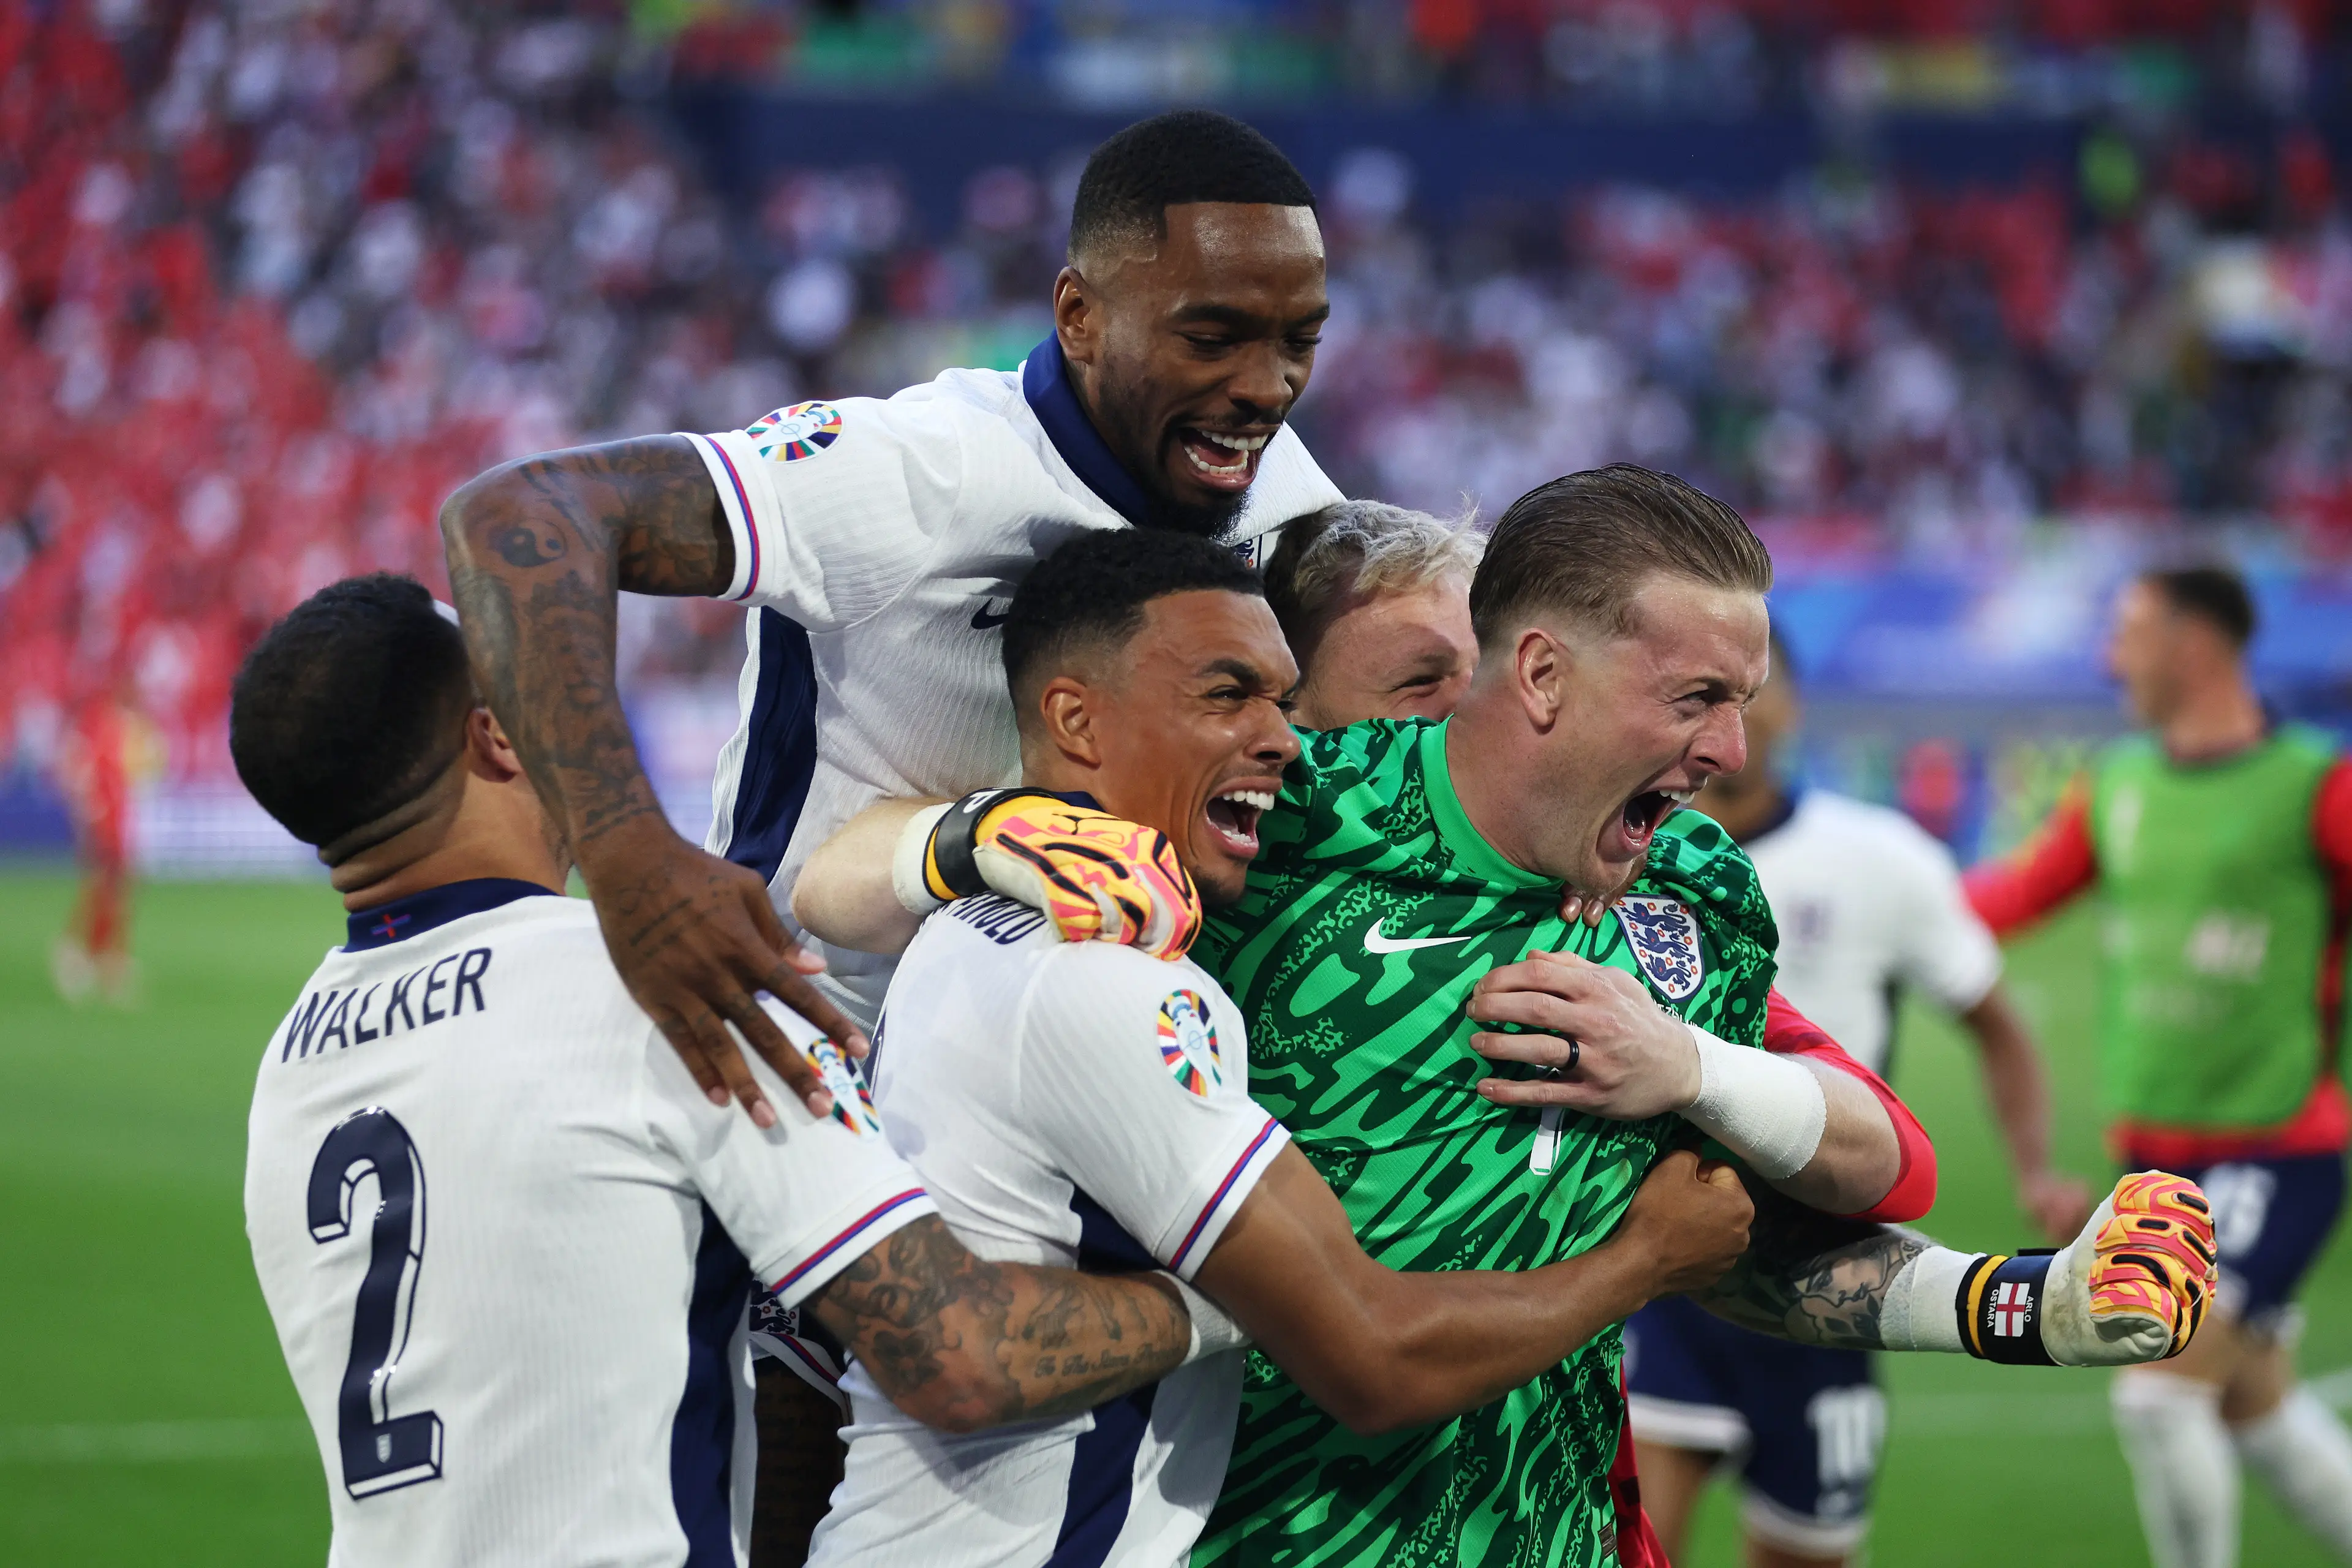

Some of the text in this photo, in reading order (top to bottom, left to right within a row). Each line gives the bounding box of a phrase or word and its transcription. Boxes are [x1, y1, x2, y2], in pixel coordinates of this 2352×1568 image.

[282, 948, 492, 1063] WALKER
[307, 1105, 443, 1502] 2
[1986, 1289, 1999, 1328] OSTARA
[2024, 1295, 2034, 1322] ARLO
